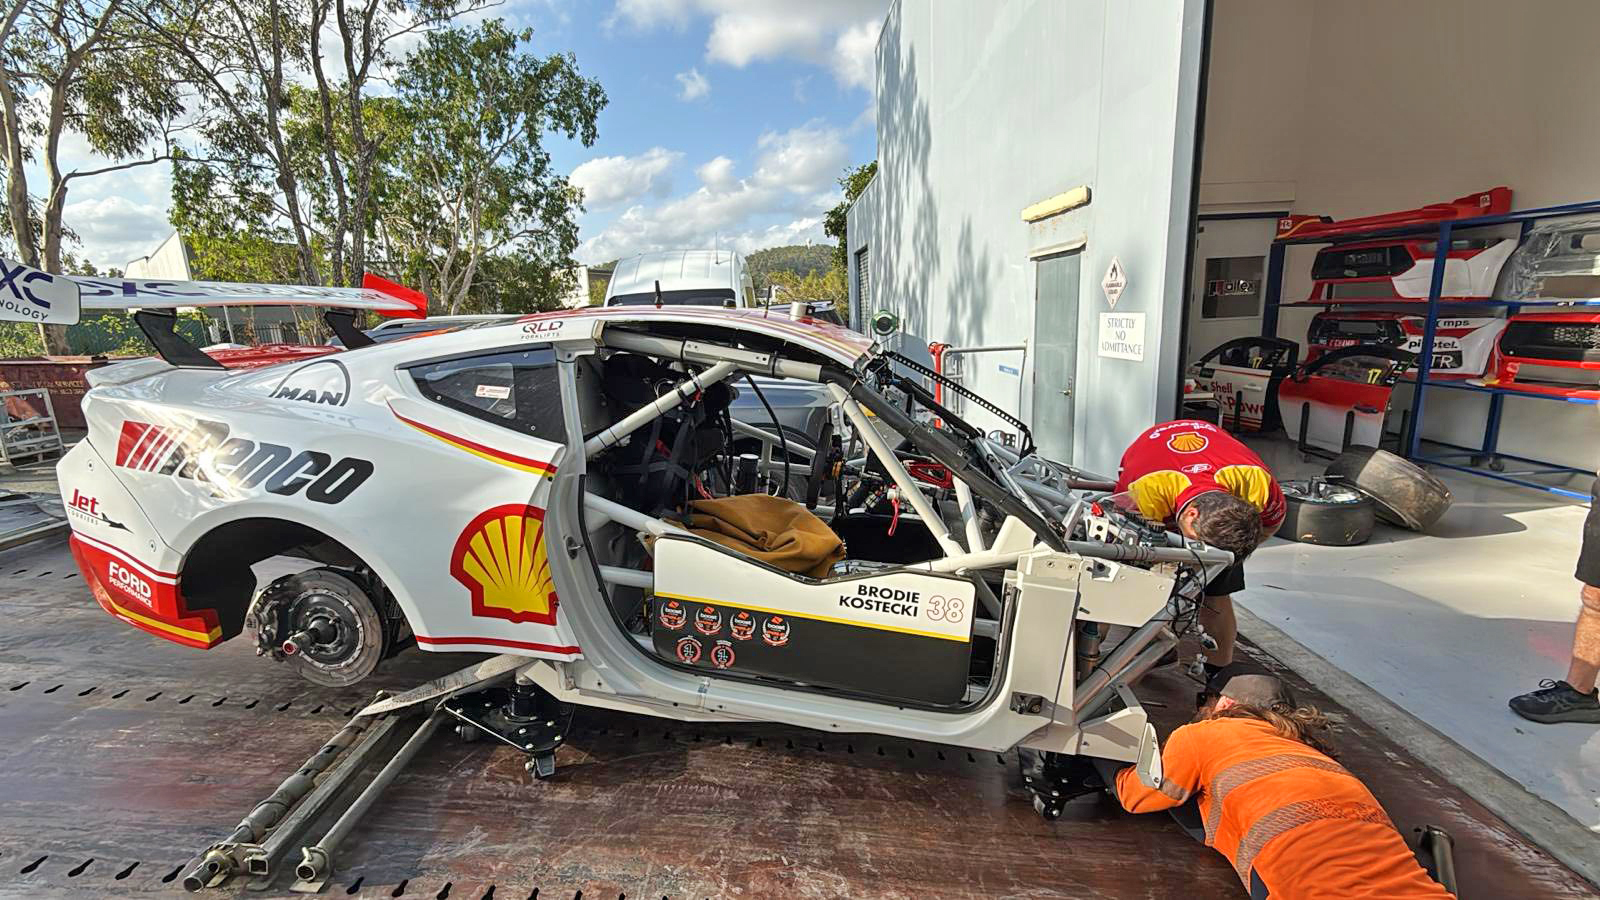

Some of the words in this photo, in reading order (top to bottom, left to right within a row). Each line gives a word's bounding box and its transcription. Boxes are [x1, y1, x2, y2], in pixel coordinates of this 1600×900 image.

[522, 320, 564, 334] QLD
[1107, 317, 1137, 329] STRICTLY
[1443, 319, 1470, 327] mps
[1115, 330, 1127, 341] NO
[1252, 357, 1263, 368] 17
[1367, 368, 1382, 384] 17
[275, 386, 343, 406] MAN
[1211, 381, 1233, 393] Shell
[68, 488, 100, 516] Jet
[108, 561, 152, 599] FORD
[109, 575, 153, 608] PERFORMANCE
[857, 584, 920, 604] BRODIE
[839, 595, 919, 617] KOSTECKI
[926, 594, 965, 624] 38
